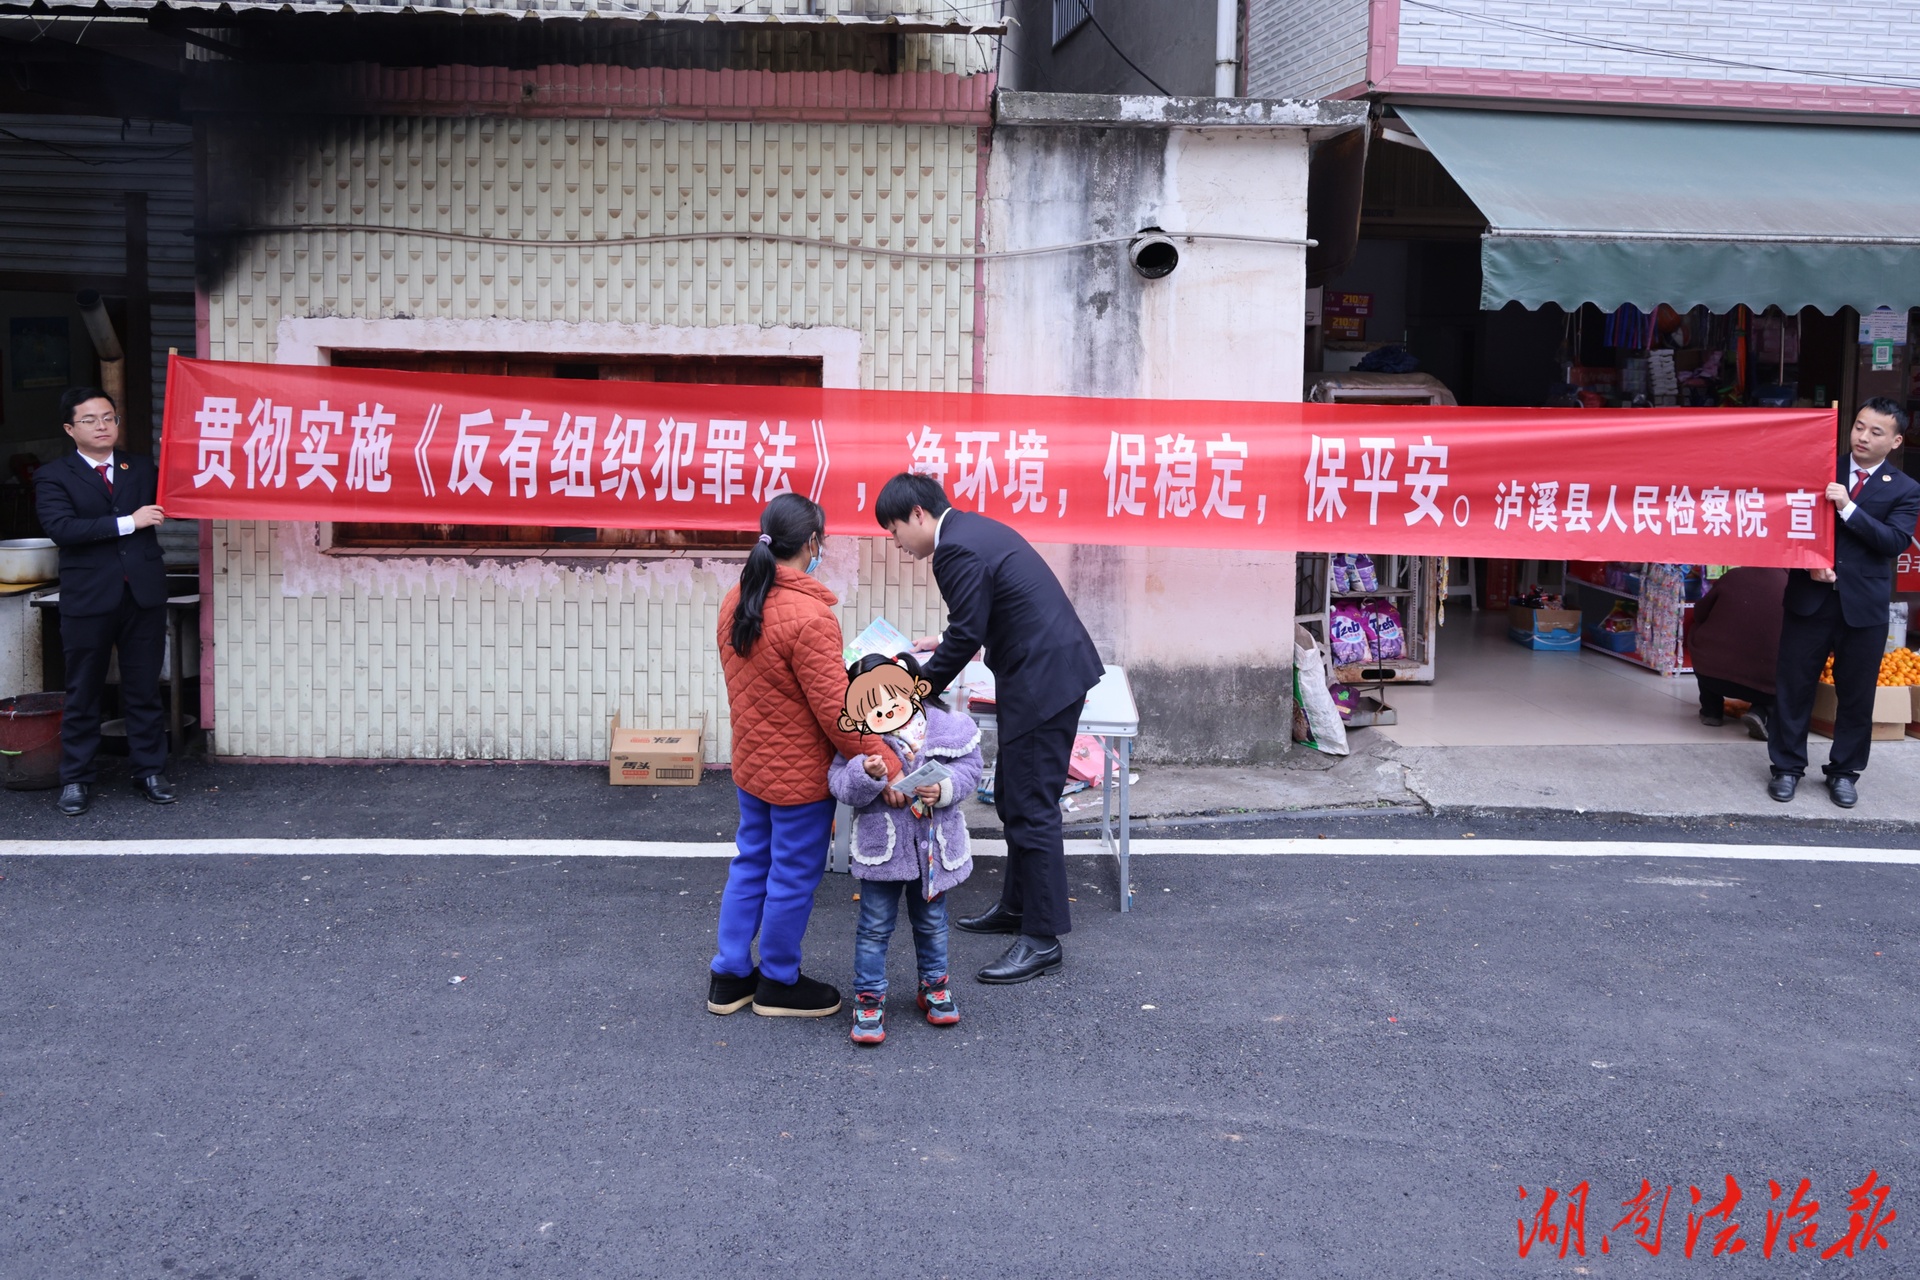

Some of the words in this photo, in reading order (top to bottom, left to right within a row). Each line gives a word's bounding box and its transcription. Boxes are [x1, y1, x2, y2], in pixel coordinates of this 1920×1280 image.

[1494, 480, 1768, 538] 泸溪县人民检察院
[1785, 489, 1816, 540] 宣
